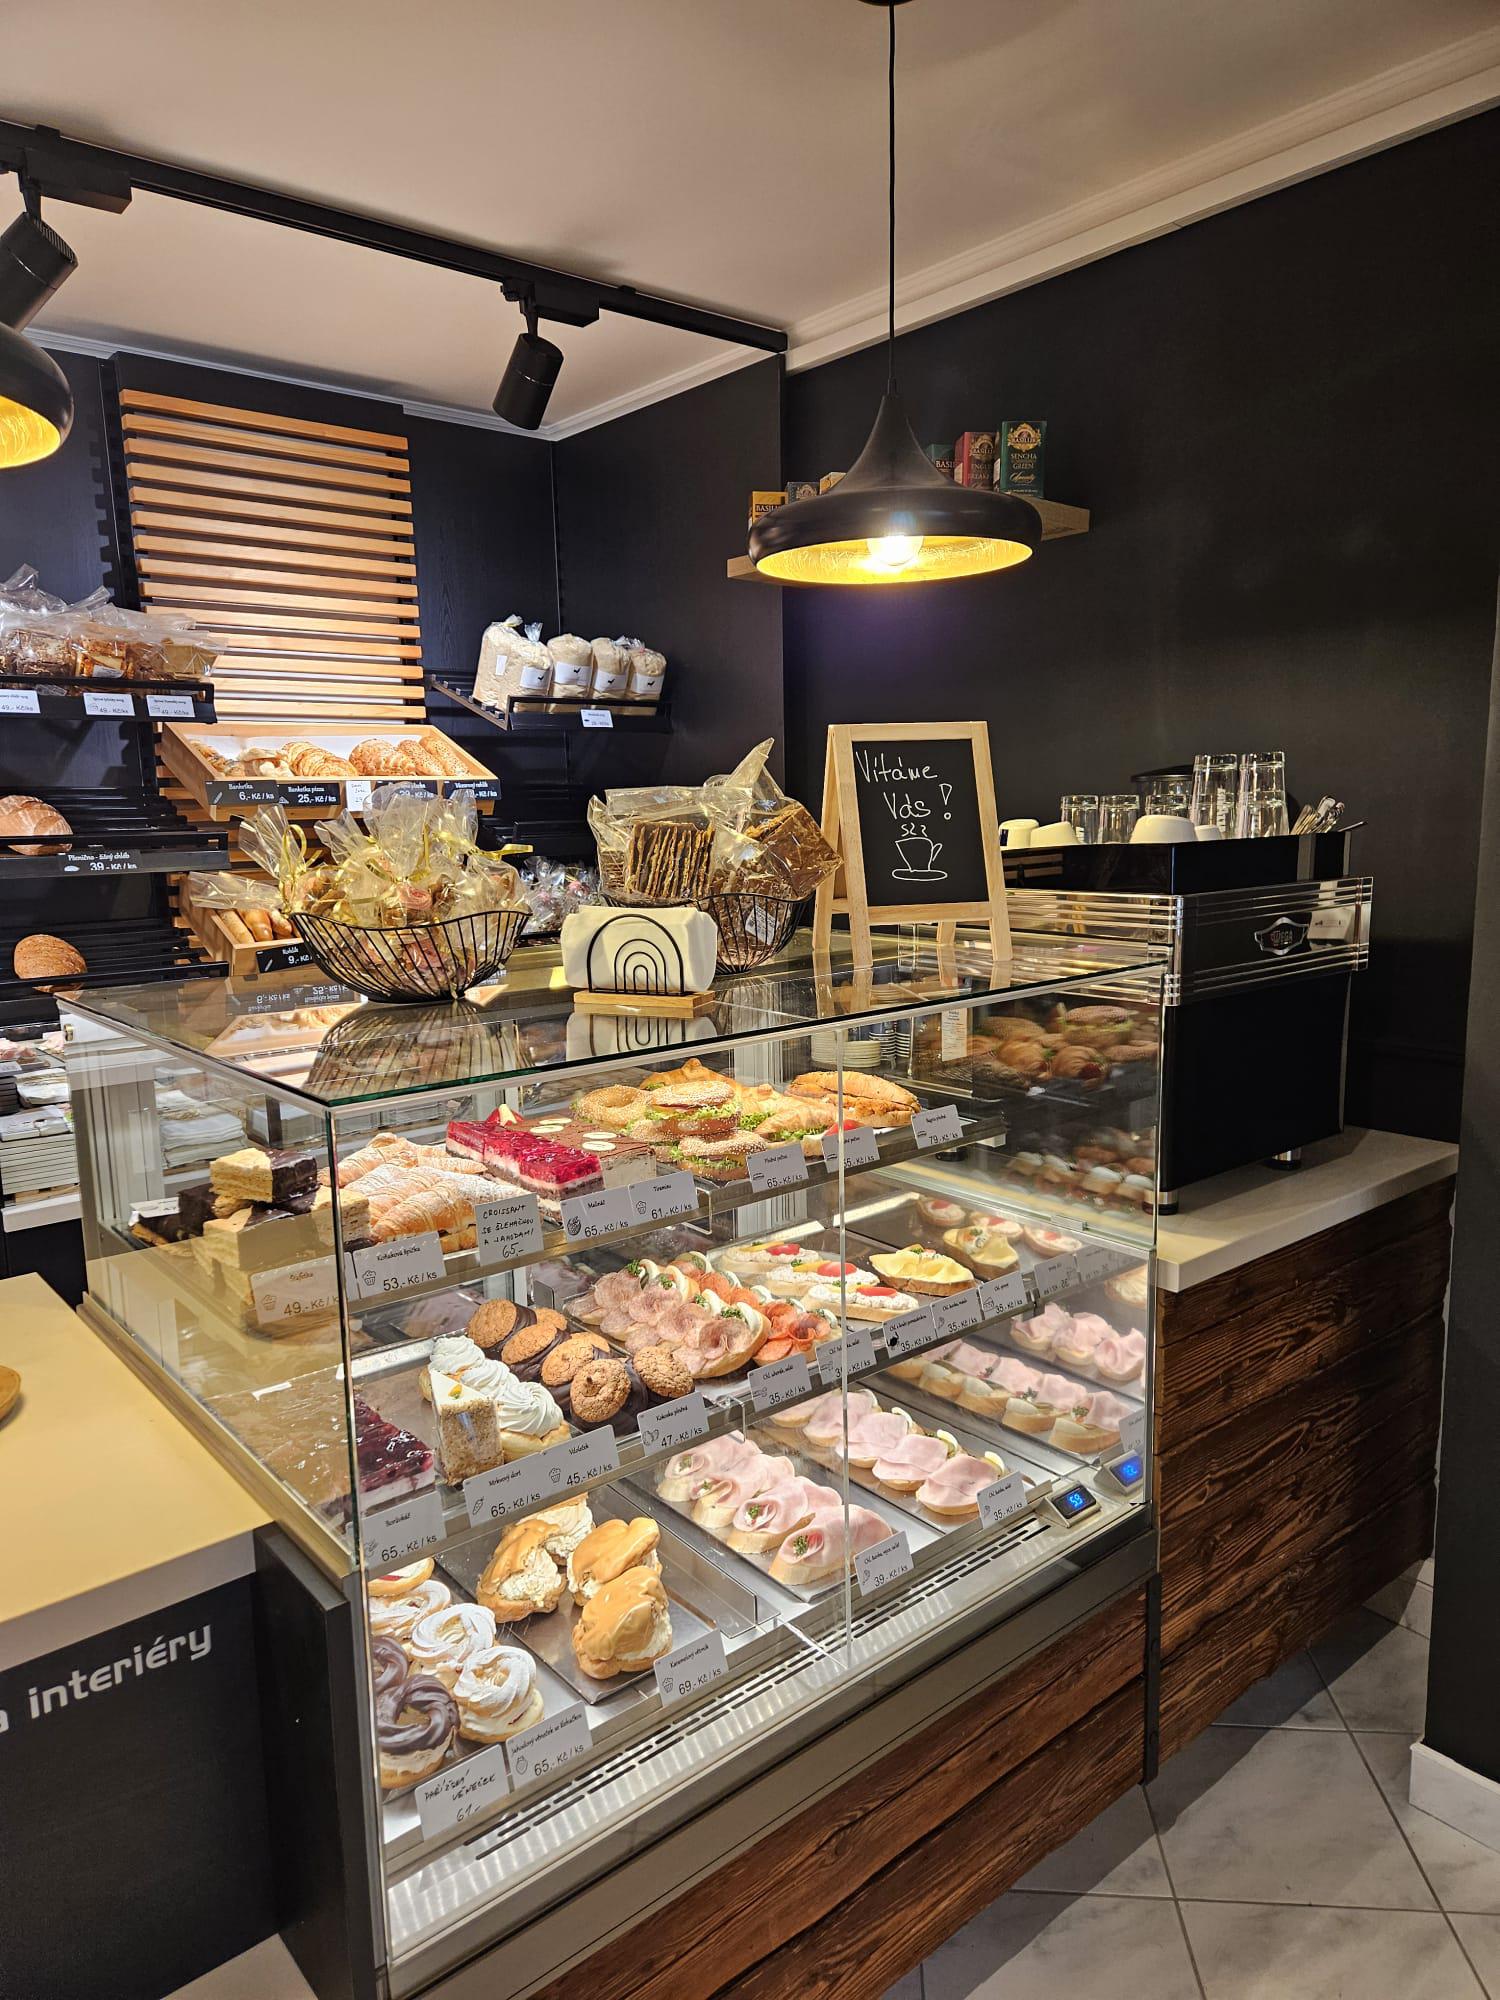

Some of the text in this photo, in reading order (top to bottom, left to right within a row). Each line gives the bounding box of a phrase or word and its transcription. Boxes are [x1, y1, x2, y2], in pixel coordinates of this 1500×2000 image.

[238, 791, 251, 801] 6,-
[265, 792, 275, 800] ks
[298, 794, 314, 804] 25,-
[314, 795, 325, 803] Kč
[883, 792, 931, 820] Vás
[288, 955, 300, 964] 9,-
[482, 1204, 526, 1220] CROISSANT
[651, 1207, 669, 1220] 61,-
[669, 1206, 679, 1215] Kč
[684, 1203, 692, 1211] ks
[584, 1225, 603, 1238] 65,-
[604, 1221, 615, 1232] Kč
[619, 1220, 629, 1228] ks
[383, 1277, 406, 1292] 53,-
[407, 1275, 420, 1285] Kč
[427, 1271, 438, 1280] ks
[283, 1301, 309, 1316] 49,-
[310, 1298, 325, 1310] Kč
[960, 1319, 968, 1327] Kč
[914, 1338, 922, 1346] Kč
[852, 1362, 861, 1372] Kč
[768, 1391, 785, 1405] 35,-
[785, 1389, 794, 1399] Kč
[797, 1385, 806, 1393] ks
[661, 1434, 679, 1448] 47,-
[679, 1431, 689, 1441] Kč
[693, 1427, 703, 1436] ks
[566, 1471, 586, 1486] 45,-
[586, 1467, 598, 1479] Kč
[603, 1463, 613, 1472] ks
[490, 1502, 512, 1518] 65,-
[513, 1498, 525, 1509] Kč
[530, 1492, 541, 1502] ks
[1006, 1505, 1014, 1515] Kč
[381, 1545, 405, 1562] 65,-
[406, 1539, 420, 1553] Kč
[426, 1535, 438, 1544] ks
[889, 1568, 898, 1579] Kč
[900, 1564, 908, 1572] ks
[28, 1624, 212, 1720] interiéry
[678, 1680, 697, 1695] 69,-
[697, 1673, 709, 1685] Kč
[712, 1668, 722, 1678] ks
[534, 1757, 555, 1777] 65,-
[556, 1751, 569, 1765] Kč
[574, 1744, 584, 1754] ks
